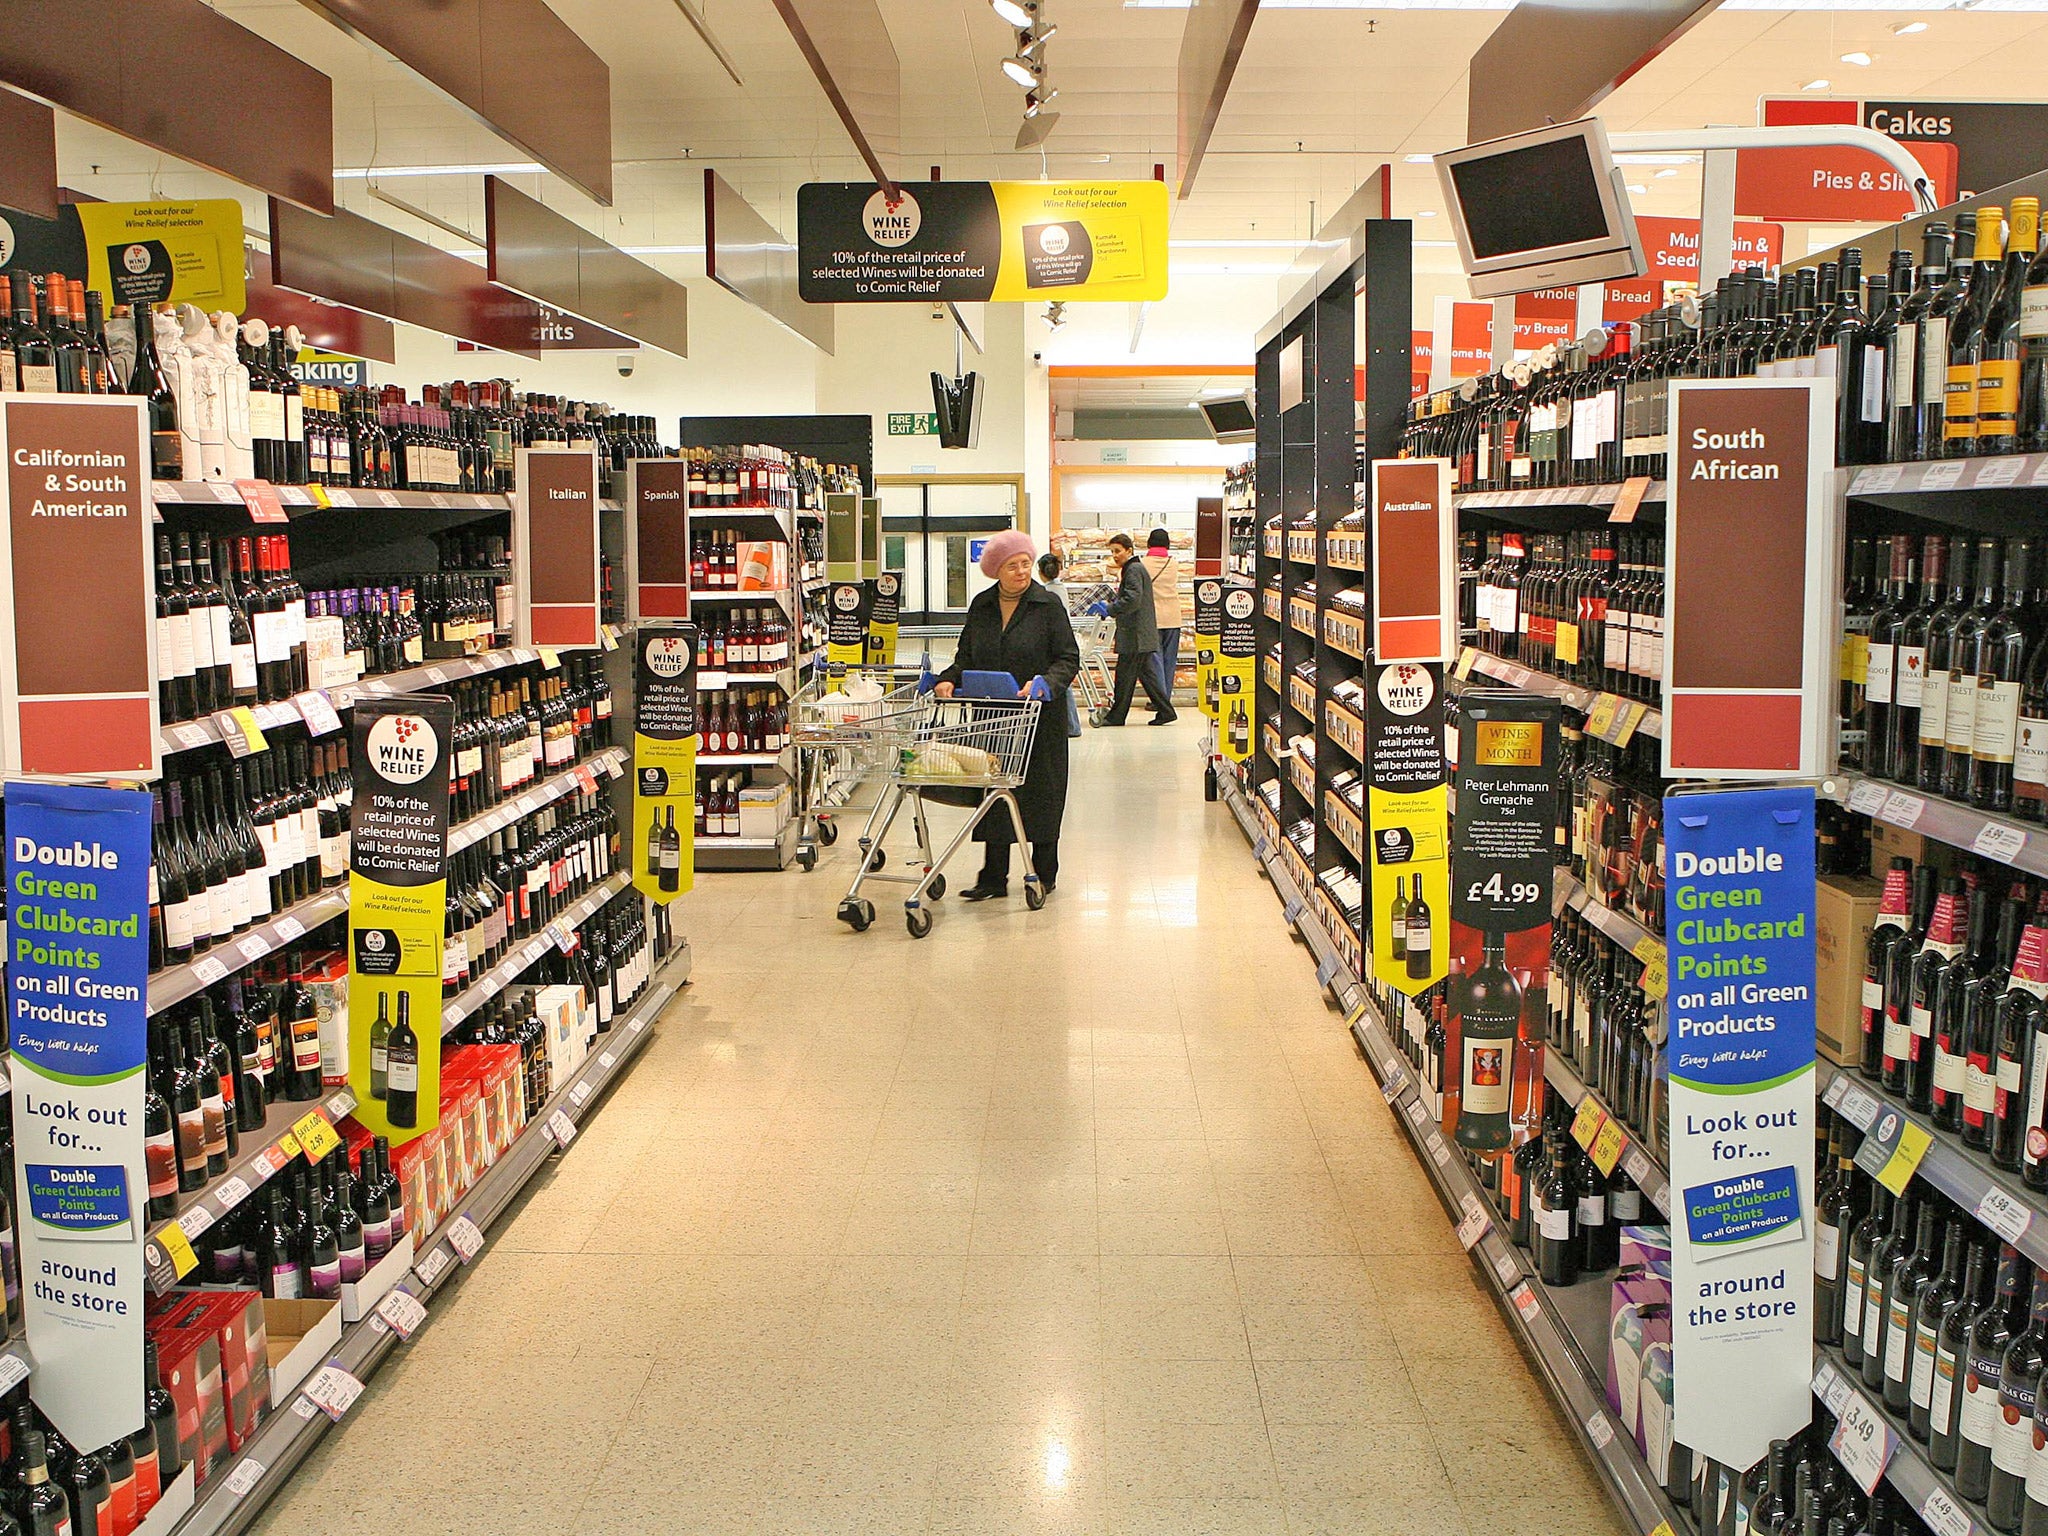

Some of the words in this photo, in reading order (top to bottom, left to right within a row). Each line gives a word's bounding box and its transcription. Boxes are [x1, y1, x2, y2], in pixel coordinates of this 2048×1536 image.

[1870, 109, 1952, 135] Cakes
[1812, 169, 1853, 189] Pies
[1858, 171, 1874, 191] &
[1878, 172, 1936, 192] Slis
[1053, 188, 1073, 196] Look
[1089, 188, 1102, 197] for
[1043, 200, 1065, 208] Wine
[1065, 200, 1090, 209] Relief
[1091, 200, 1127, 208] selection
[872, 217, 911, 228] WINE
[874, 229, 911, 239] RELIEF
[1756, 237, 1768, 252] &
[832, 252, 856, 264] 10%
[857, 251, 871, 263] of
[871, 252, 890, 263] the
[892, 252, 922, 263] retail
[923, 252, 951, 265] price
[953, 251, 966, 263] of
[812, 267, 860, 278] selected
[861, 267, 897, 278] Wines
[898, 267, 919, 278] will
[920, 266, 935, 278] be
[936, 266, 985, 278] donated
[855, 283, 869, 293] to
[870, 281, 907, 293] Comic
[908, 281, 941, 293] Relief
[1612, 290, 1651, 303] Bread
[1533, 323, 1568, 334] Bread
[291, 362, 359, 384] aking
[890, 415, 911, 424] FIRE
[890, 424, 911, 433] EXIT
[1692, 428, 1765, 449] South
[14, 448, 126, 467] Californian
[1690, 459, 1779, 480] African
[45, 474, 61, 492] &
[66, 474, 127, 492] South
[548, 487, 587, 500] Italian
[644, 490, 680, 502] Spanish
[31, 499, 127, 517] American
[1383, 501, 1432, 512] Australian
[653, 654, 682, 664] WINE
[654, 663, 682, 672] RELIEF
[1388, 687, 1423, 698] WINE
[1389, 699, 1424, 708] RELIEF
[1383, 725, 1403, 735] 10%
[1403, 725, 1414, 734] of
[1414, 725, 1429, 734] the
[1489, 728, 1530, 739] WINES
[1378, 737, 1401, 747] retail
[1402, 736, 1424, 748] price
[1425, 736, 1435, 745] of
[379, 745, 425, 762] WINE
[1374, 749, 1411, 759] selected
[1411, 748, 1440, 758] Wines
[1486, 748, 1532, 759] MONTH
[380, 761, 425, 776] RELIEF
[1373, 760, 1389, 770] will
[1390, 760, 1401, 770] be
[1402, 759, 1441, 769] donated
[1375, 773, 1385, 782] to
[1386, 771, 1414, 782] Comic
[1415, 770, 1441, 780] Relief
[1465, 779, 1495, 791] Peter
[1496, 780, 1549, 792] Lehmann
[372, 795, 395, 808] 10%
[396, 797, 409, 809] of
[410, 798, 429, 811] the
[1480, 793, 1534, 806] Grenache
[364, 811, 393, 823] retail
[393, 813, 422, 826] price
[423, 815, 437, 827] of
[358, 825, 404, 839] selected
[405, 828, 440, 843] Wines
[15, 837, 118, 870] Double
[357, 840, 376, 852] will
[377, 841, 391, 854] be
[393, 842, 440, 858] donated
[358, 856, 370, 867] to
[371, 855, 407, 870] Comic
[408, 859, 441, 873] Relief
[1675, 847, 1783, 878] Double
[15, 870, 97, 901] Green
[1466, 872, 1540, 903] £4.99
[372, 893, 388, 901] Look
[400, 896, 411, 904] for
[1675, 885, 1762, 911] Green
[364, 902, 381, 910] Wine
[381, 903, 402, 913] Relief
[401, 906, 431, 914] selection
[15, 905, 139, 938] Clubcard
[1676, 913, 1805, 946] Clubcard
[16, 938, 101, 969] Points
[1677, 954, 1768, 981] Points
[15, 975, 41, 993] on
[46, 975, 70, 995] all
[75, 976, 140, 1002] Green
[1677, 991, 1704, 1010] on
[1710, 985, 1735, 1008] all
[1741, 984, 1808, 1005] Green
[17, 999, 108, 1027] Products
[1677, 1013, 1776, 1039] Products
[18, 1034, 46, 1052] Every
[48, 1037, 71, 1051] little
[73, 1040, 100, 1055] helps
[1678, 1053, 1709, 1069] Every
[1712, 1051, 1738, 1064] little
[1739, 1049, 1768, 1062] helps
[26, 1094, 80, 1121] Look
[87, 1107, 127, 1127] out
[1687, 1110, 1747, 1135] Look
[1755, 1108, 1798, 1130] out
[48, 1125, 102, 1152] for...
[1712, 1140, 1771, 1161] for...
[50, 1169, 96, 1183] Double
[33, 1183, 66, 1196] Green
[67, 1185, 121, 1197] Clubcard
[1713, 1177, 1765, 1199] Double
[58, 1198, 96, 1211] Points
[1692, 1202, 1731, 1218] Green
[1732, 1186, 1791, 1208] Clubcard
[1986, 1195, 2009, 1211] £4.98
[52, 1211, 61, 1219] all
[61, 1212, 84, 1220] Green
[84, 1213, 119, 1221] Products
[1722, 1208, 1764, 1225] Points
[1702, 1232, 1713, 1240] on
[1714, 1228, 1724, 1237] all
[1725, 1223, 1750, 1234] Green
[1751, 1215, 1789, 1228] Products
[41, 1259, 117, 1288] around
[1699, 1269, 1786, 1298] around
[34, 1281, 65, 1305] the
[71, 1292, 128, 1316] store
[1688, 1305, 1727, 1327] the
[1734, 1299, 1797, 1322] store
[1846, 1406, 1874, 1442] £3.49
[1931, 1497, 1952, 1515] £4.49
